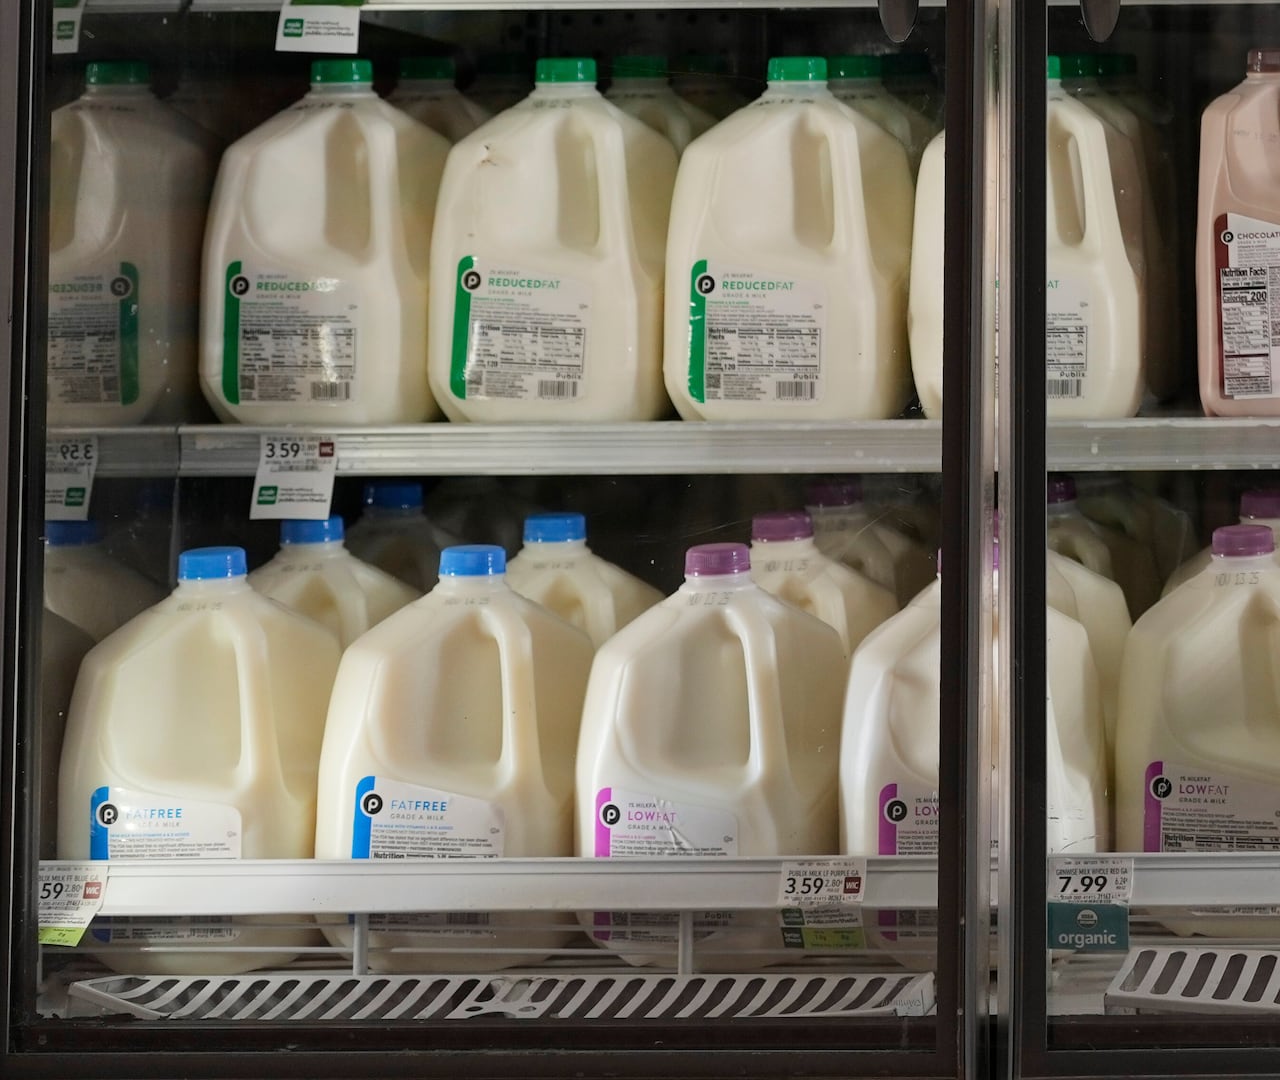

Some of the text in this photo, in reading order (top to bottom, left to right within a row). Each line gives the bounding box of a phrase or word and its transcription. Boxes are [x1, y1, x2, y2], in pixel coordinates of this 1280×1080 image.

[1222, 268, 1267, 277] Nutrition Facts
[488, 278, 561, 291] REDUCEDFAT
[721, 280, 794, 291] REDUCEDFAT
[1223, 291, 1267, 302] Calories 200
[266, 442, 300, 459] 3.59
[1179, 784, 1229, 796] LOWFAT
[391, 800, 447, 811] FATFREE
[627, 810, 677, 821] LOWFAT
[785, 877, 823, 894] 3.59
[1059, 875, 1107, 893] 7.99
[1058, 930, 1116, 948] organic
